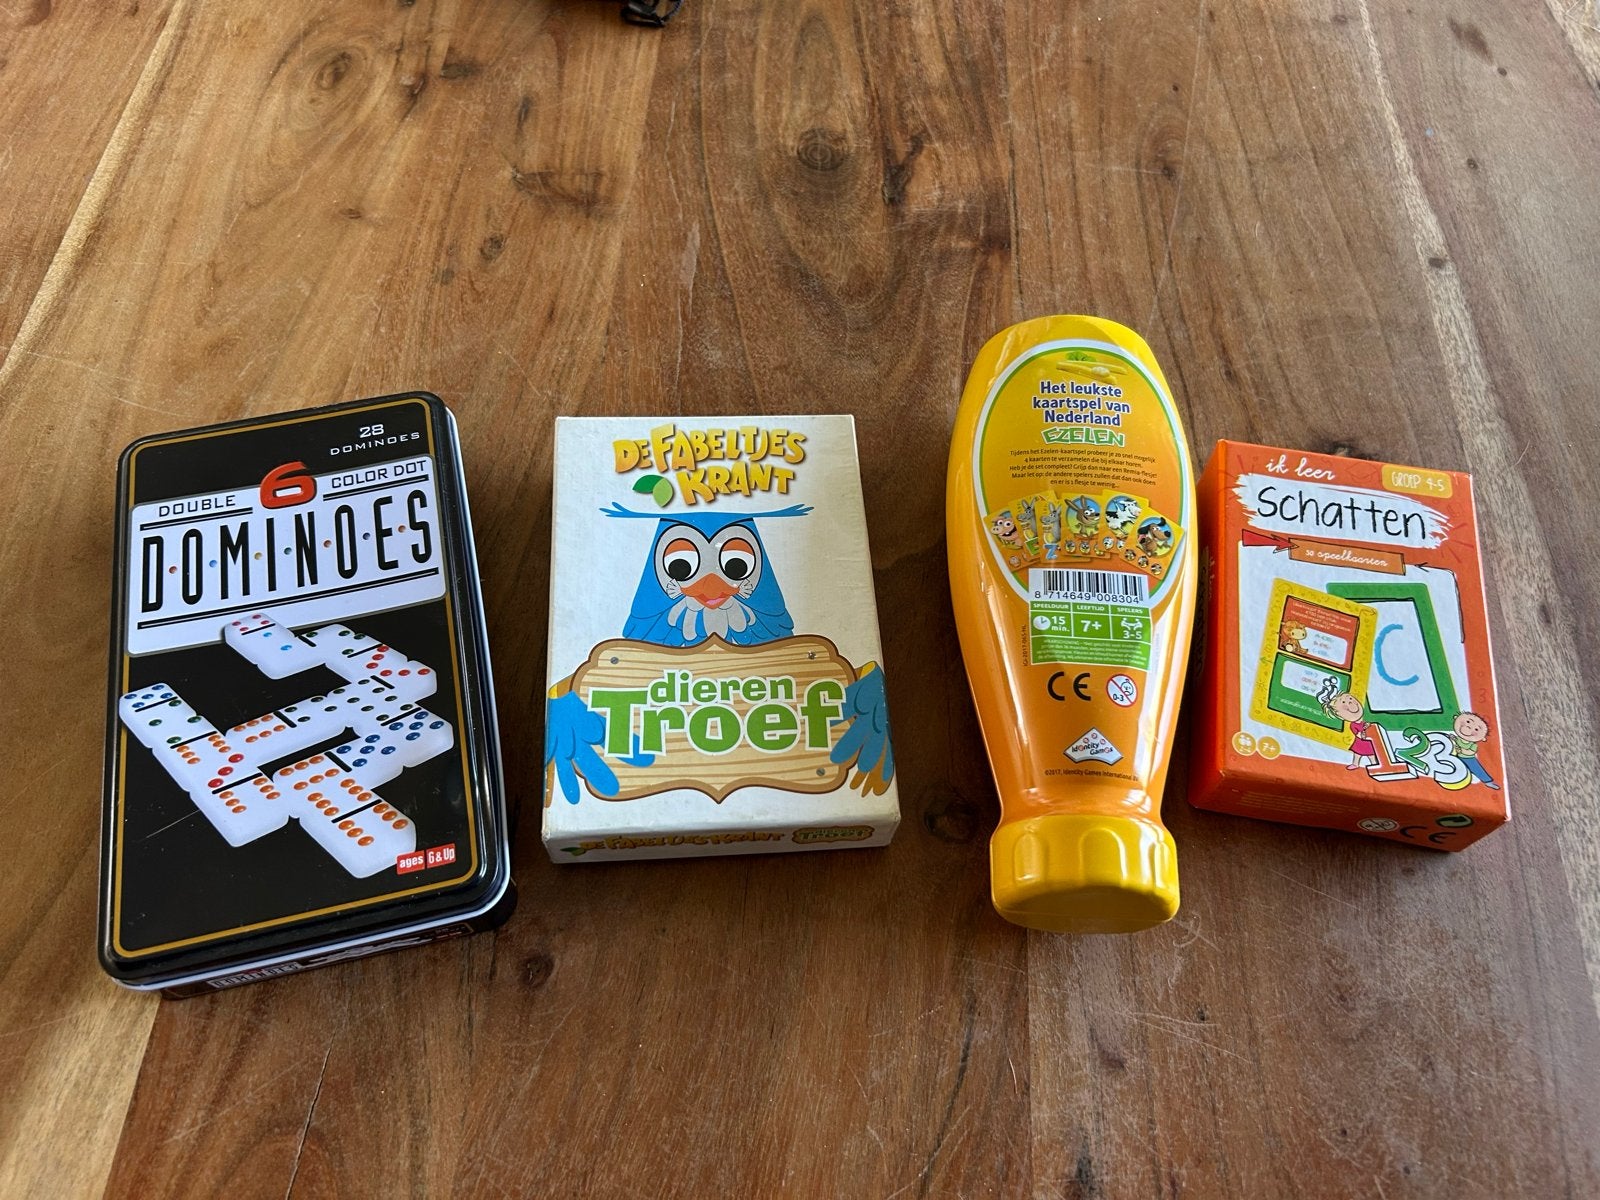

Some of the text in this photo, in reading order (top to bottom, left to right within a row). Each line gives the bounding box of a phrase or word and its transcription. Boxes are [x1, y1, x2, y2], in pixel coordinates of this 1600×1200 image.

[1040, 380, 1122, 398] Het leukste
[1032, 397, 1130, 413] kaartspel van
[1044, 410, 1121, 426] Nederland
[359, 423, 384, 439] 28
[1041, 426, 1125, 447] EZELEN
[330, 431, 421, 456] DOMINOES
[612, 423, 807, 473] DE FABELTJES
[1134, 455, 1155, 463] mogelijk
[1265, 454, 1336, 481] ik leer
[158, 460, 427, 518] DOUBLE 6 COLOR DOT
[677, 461, 796, 506] KRANT
[1391, 471, 1445, 492] GROEP 4-5
[1317, 549, 1388, 567] speelkaarten
[1034, 591, 1139, 604] 8 714649 008304
[1051, 615, 1065, 625] 15
[1080, 620, 1102, 632] 7+
[1123, 630, 1142, 639] 3-5
[650, 670, 795, 704] dieren
[1113, 694, 1124, 702] 0-3
[590, 679, 844, 756] Troef
[1263, 742, 1276, 752] 7+
[399, 855, 424, 869] ages
[428, 847, 455, 864] 6 & Up
